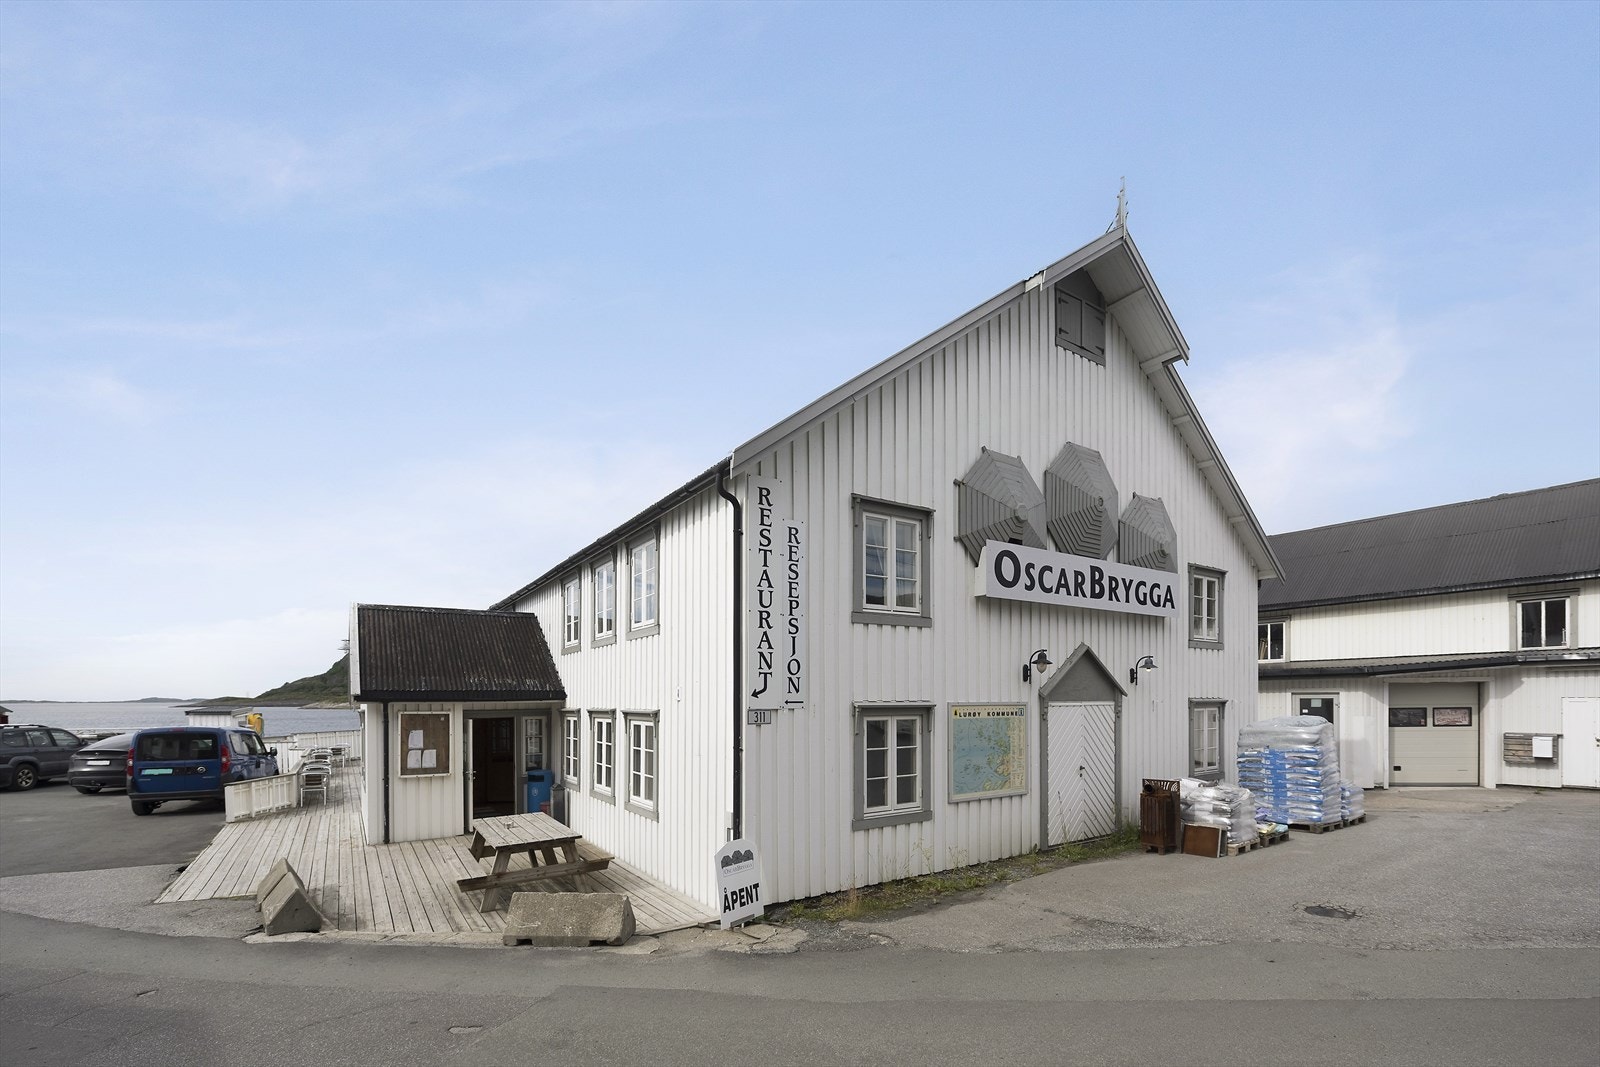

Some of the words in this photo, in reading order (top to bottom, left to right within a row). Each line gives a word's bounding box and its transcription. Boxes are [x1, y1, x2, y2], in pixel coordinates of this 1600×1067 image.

[757, 486, 774, 696] RESTAURANT
[787, 526, 801, 694] RESEPSJON
[753, 711, 766, 723] 311
[723, 883, 759, 913] ÅPENT
